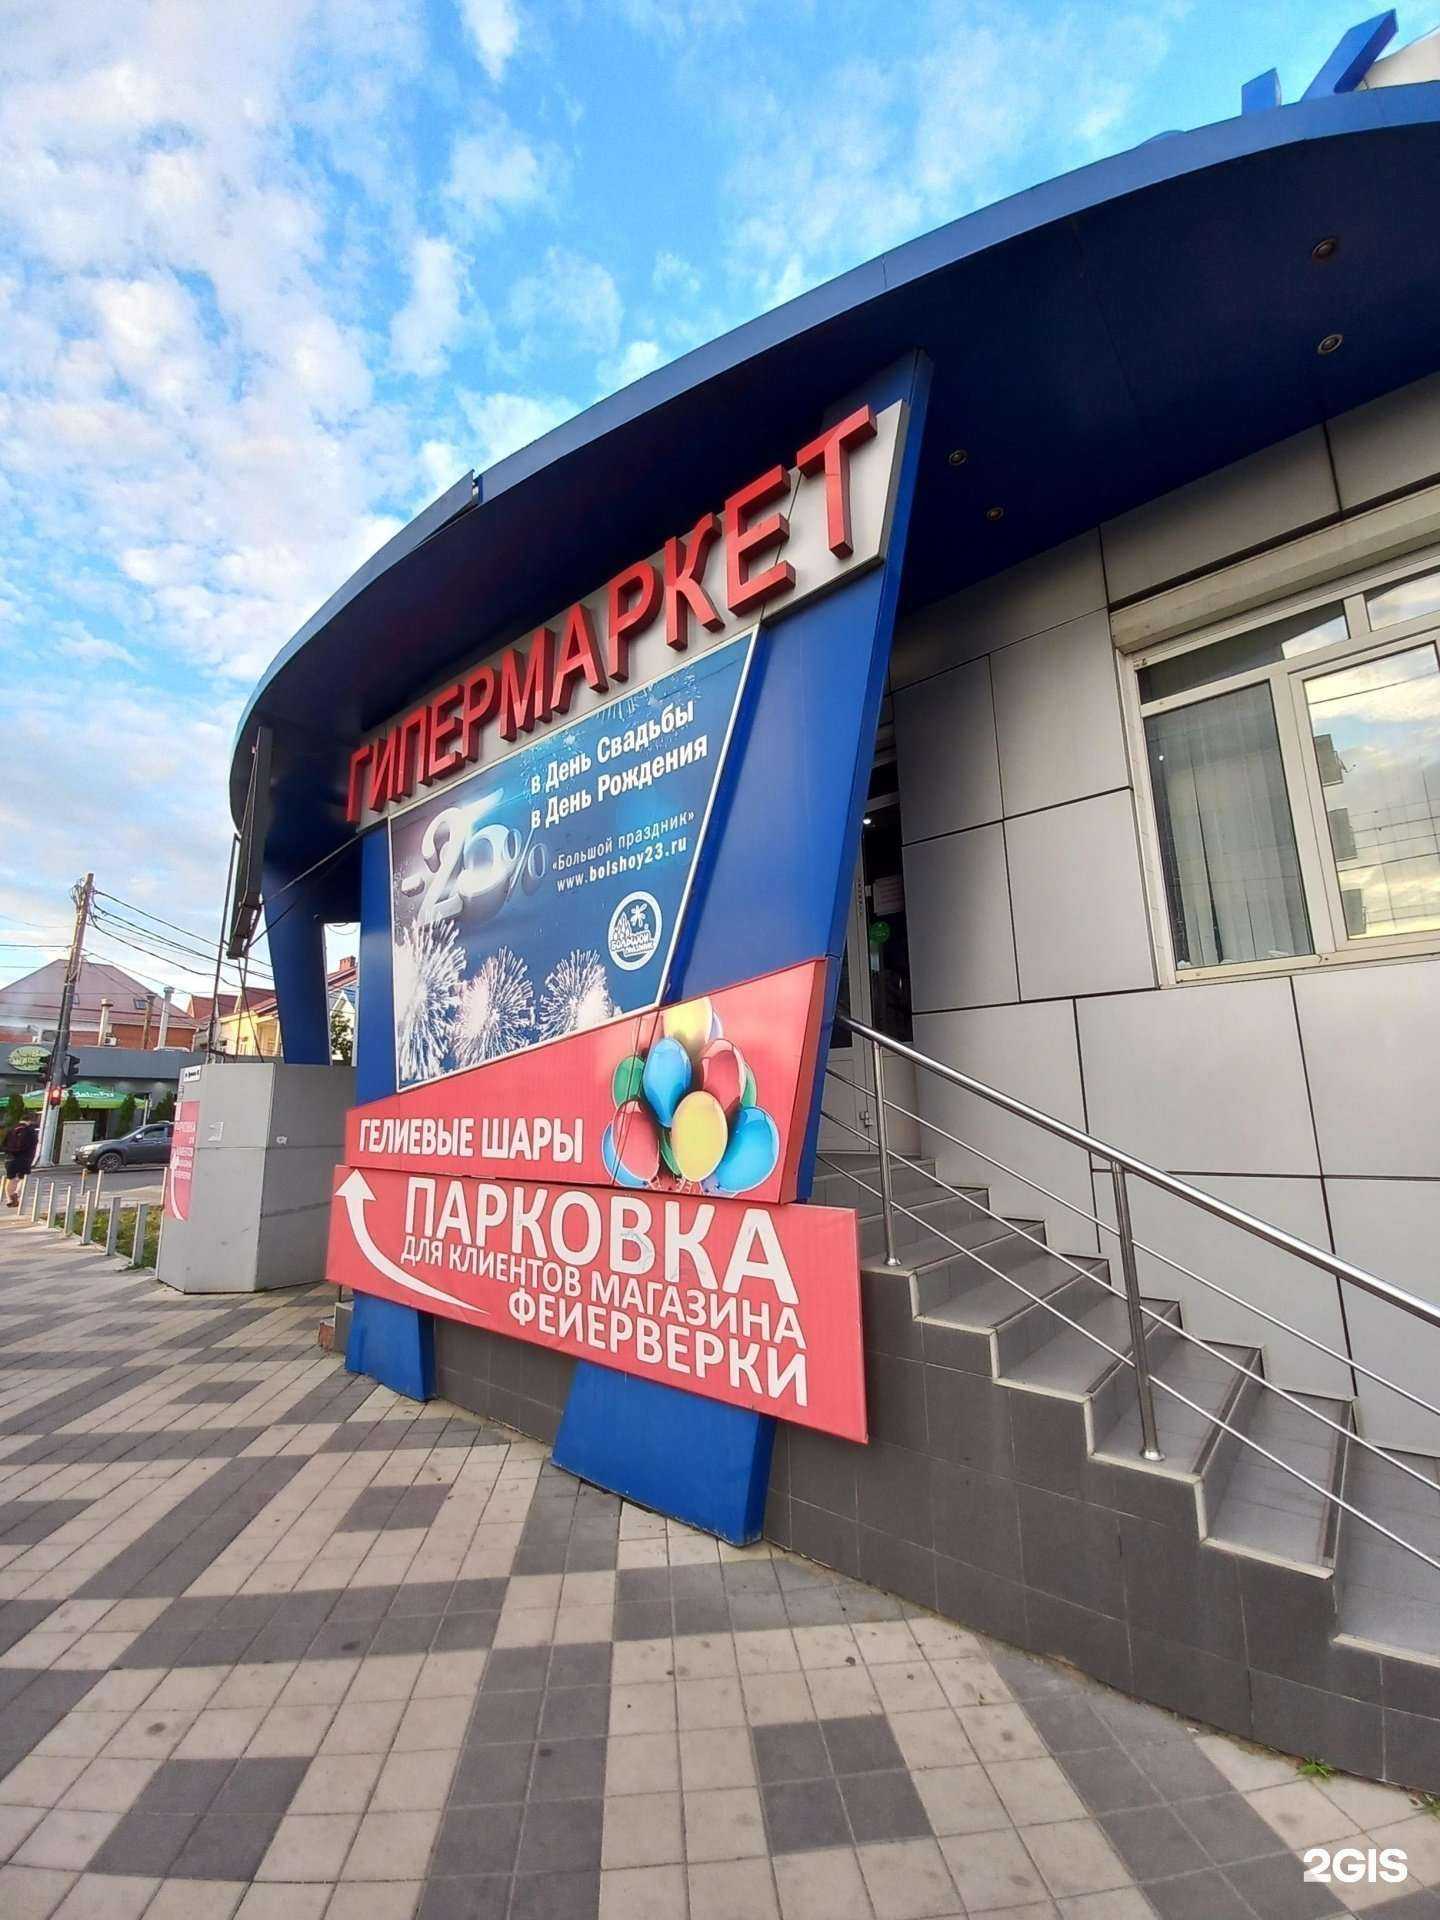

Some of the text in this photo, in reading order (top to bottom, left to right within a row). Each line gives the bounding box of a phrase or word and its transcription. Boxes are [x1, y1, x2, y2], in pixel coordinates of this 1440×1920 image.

[346, 404, 877, 824] ГИПЕРМАРКЕТ
[531, 700, 695, 795] в День Свадьбы
[531, 735, 708, 829] в День Рождения
[552, 811, 695, 871] «Большой праздник»
[557, 837, 688, 892] www.bolshoy23.ru
[359, 1117, 584, 1164] ГЕЛИЕВЫЕ ШАРЫ
[405, 1177, 800, 1305] ПАРКОВКА
[401, 1234, 807, 1350] ДЛЯ КЛИЕНТОВ МАГАЗИНА
